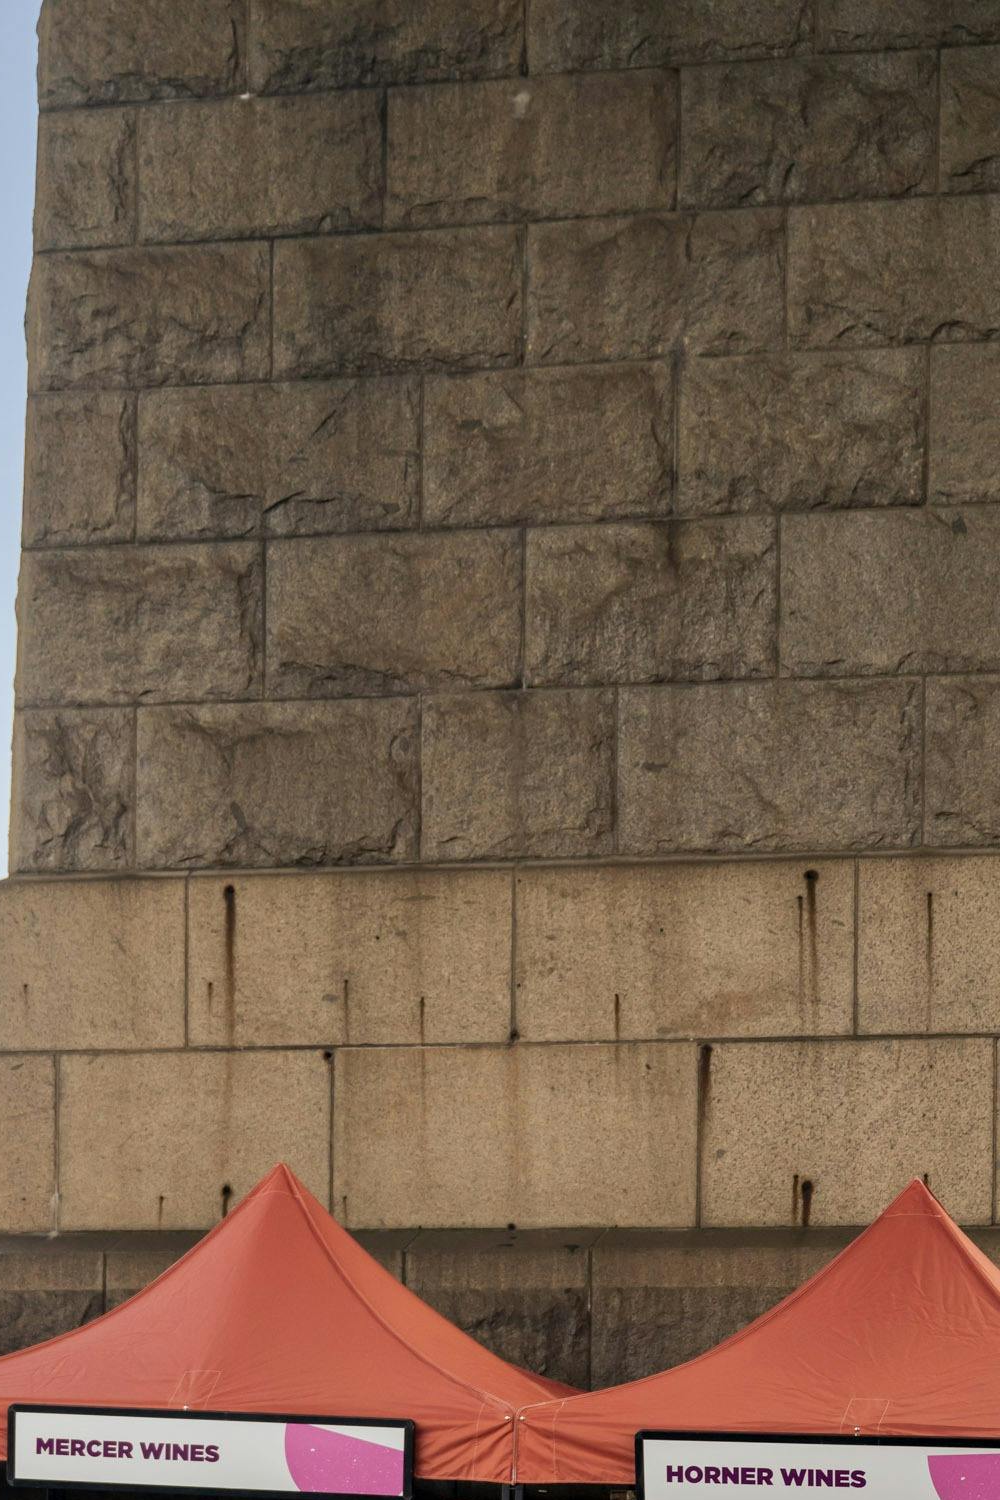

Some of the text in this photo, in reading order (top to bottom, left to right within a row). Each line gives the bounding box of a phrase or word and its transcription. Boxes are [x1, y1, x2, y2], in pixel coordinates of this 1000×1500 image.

[36, 1437, 220, 1463] MERCER WINES
[666, 1465, 867, 1488] HORNER WINES
